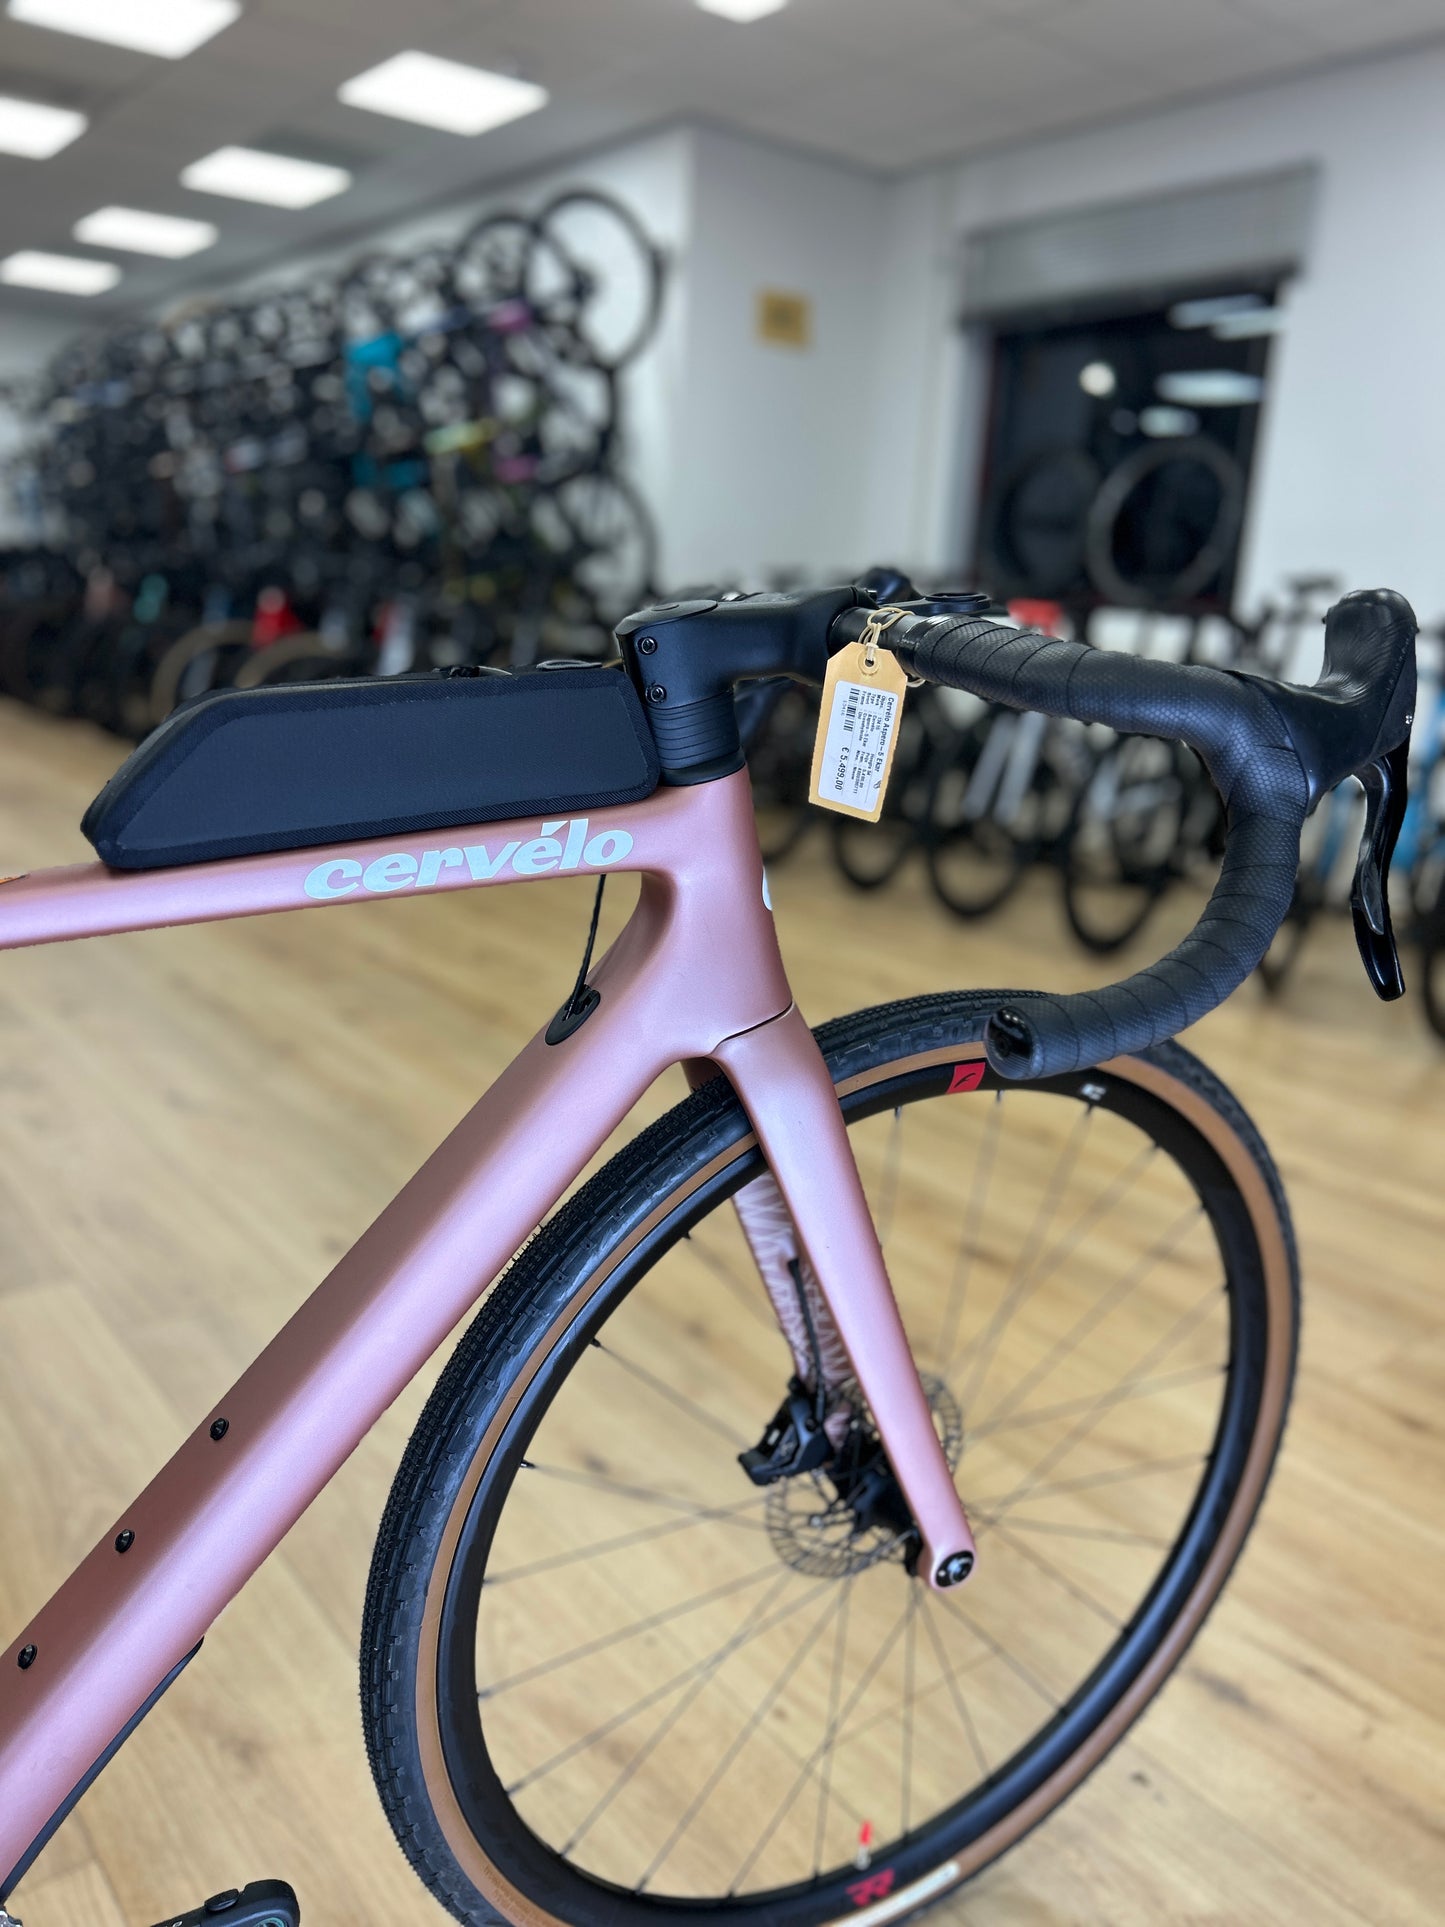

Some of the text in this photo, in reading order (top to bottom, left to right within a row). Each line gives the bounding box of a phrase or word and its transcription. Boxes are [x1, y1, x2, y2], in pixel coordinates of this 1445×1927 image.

[884, 697, 895, 722] Cervélo
[879, 723, 890, 746] Aspero
[875, 758, 883, 772] Ekar
[304, 818, 634, 900] cervélo
